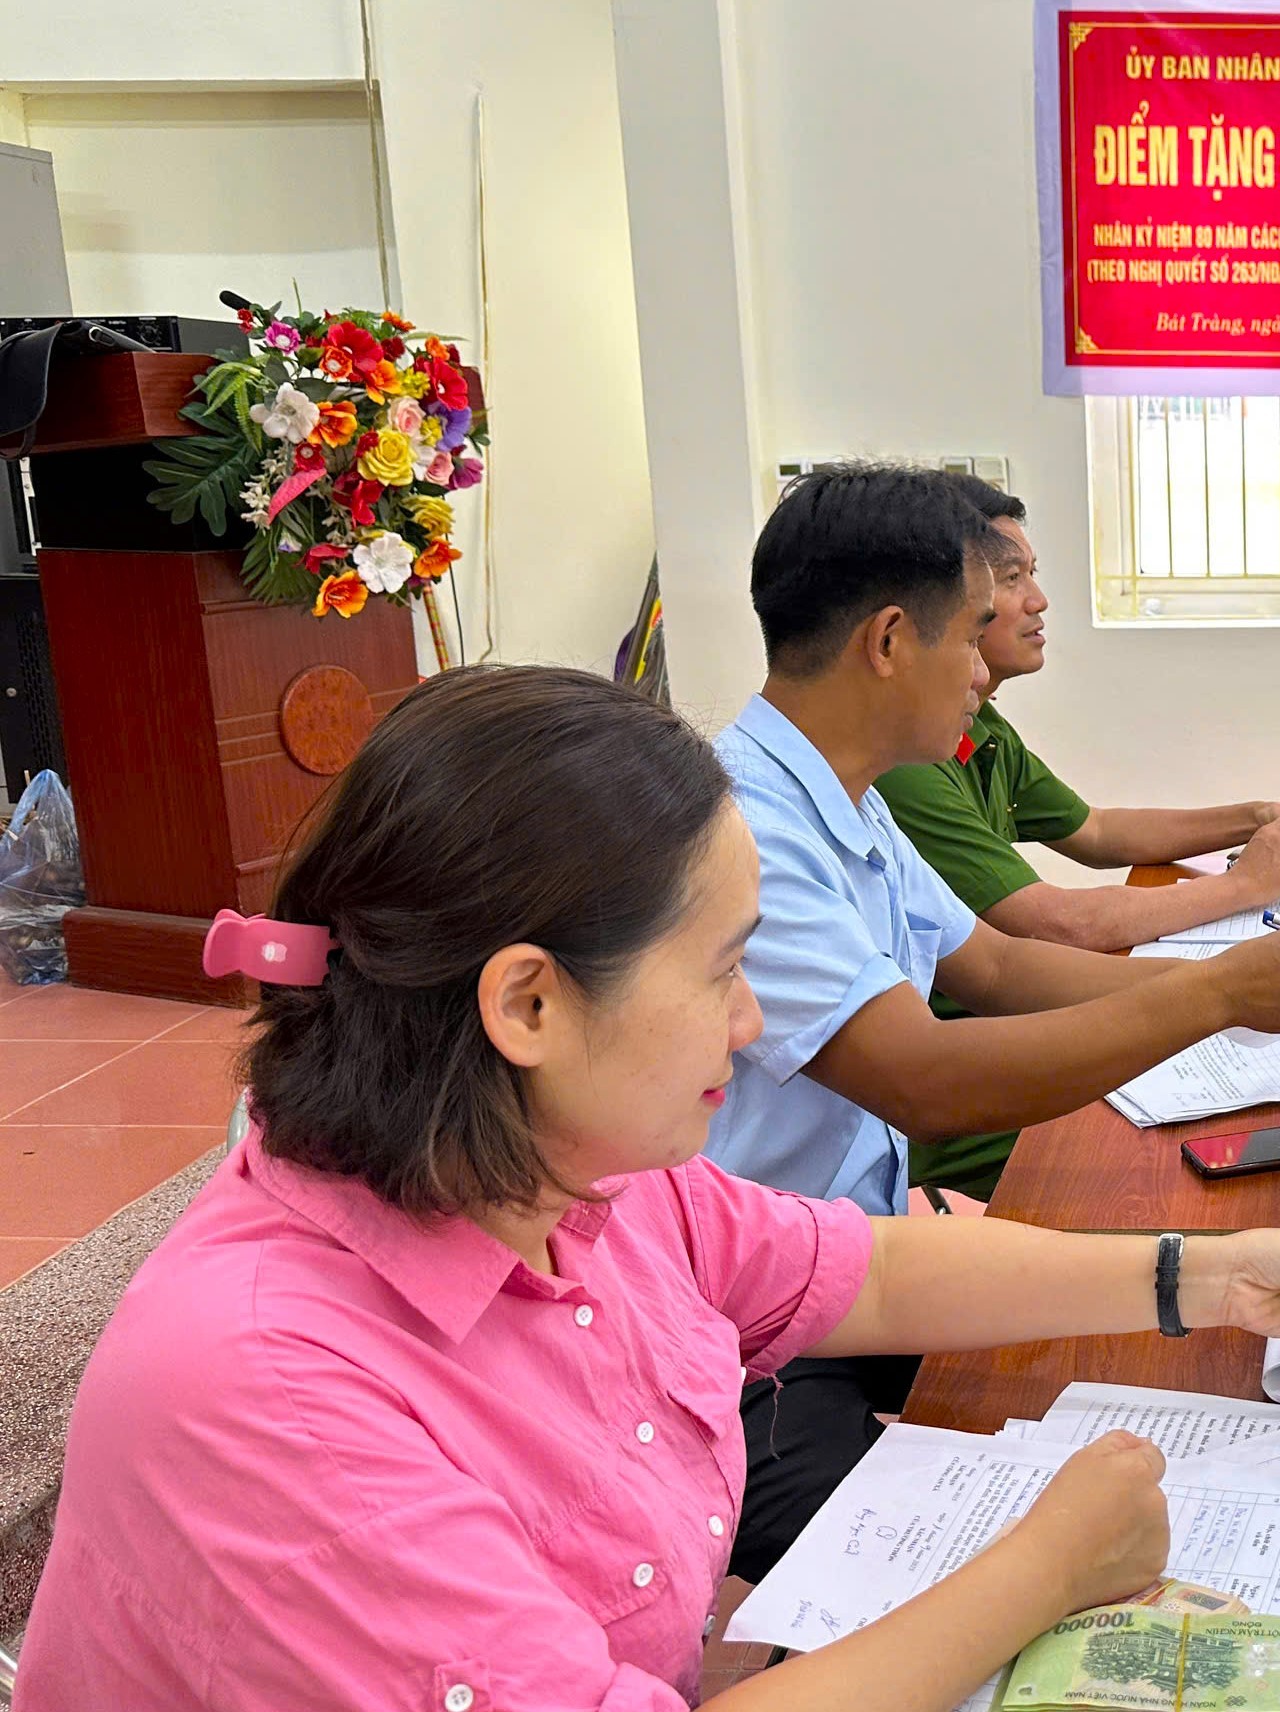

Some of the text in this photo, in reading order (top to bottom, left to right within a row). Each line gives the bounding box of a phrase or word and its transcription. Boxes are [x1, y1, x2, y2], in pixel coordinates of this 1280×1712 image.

[1126, 45, 1156, 79] ỦY
[1162, 54, 1210, 80] BAN
[1216, 52, 1280, 81] NHÂN
[1094, 100, 1179, 187] ĐIỂM
[1188, 113, 1275, 202] TẶNG
[1094, 220, 1132, 247] NHÂN
[1156, 221, 1193, 252] NIỆM
[1195, 225, 1213, 248] 80
[1215, 222, 1248, 249] NĂM
[1087, 258, 1126, 284] (THEO
[1129, 259, 1163, 287] NGHỊ
[1165, 253, 1207, 285] QUYẾT
[1210, 253, 1230, 284] SỐ
[1156, 312, 1185, 332] Bát
[1191, 312, 1246, 336] Tràng,
[1236, 1628, 1264, 1637] TRĂM
[1160, 1698, 1187, 1707] HNG
